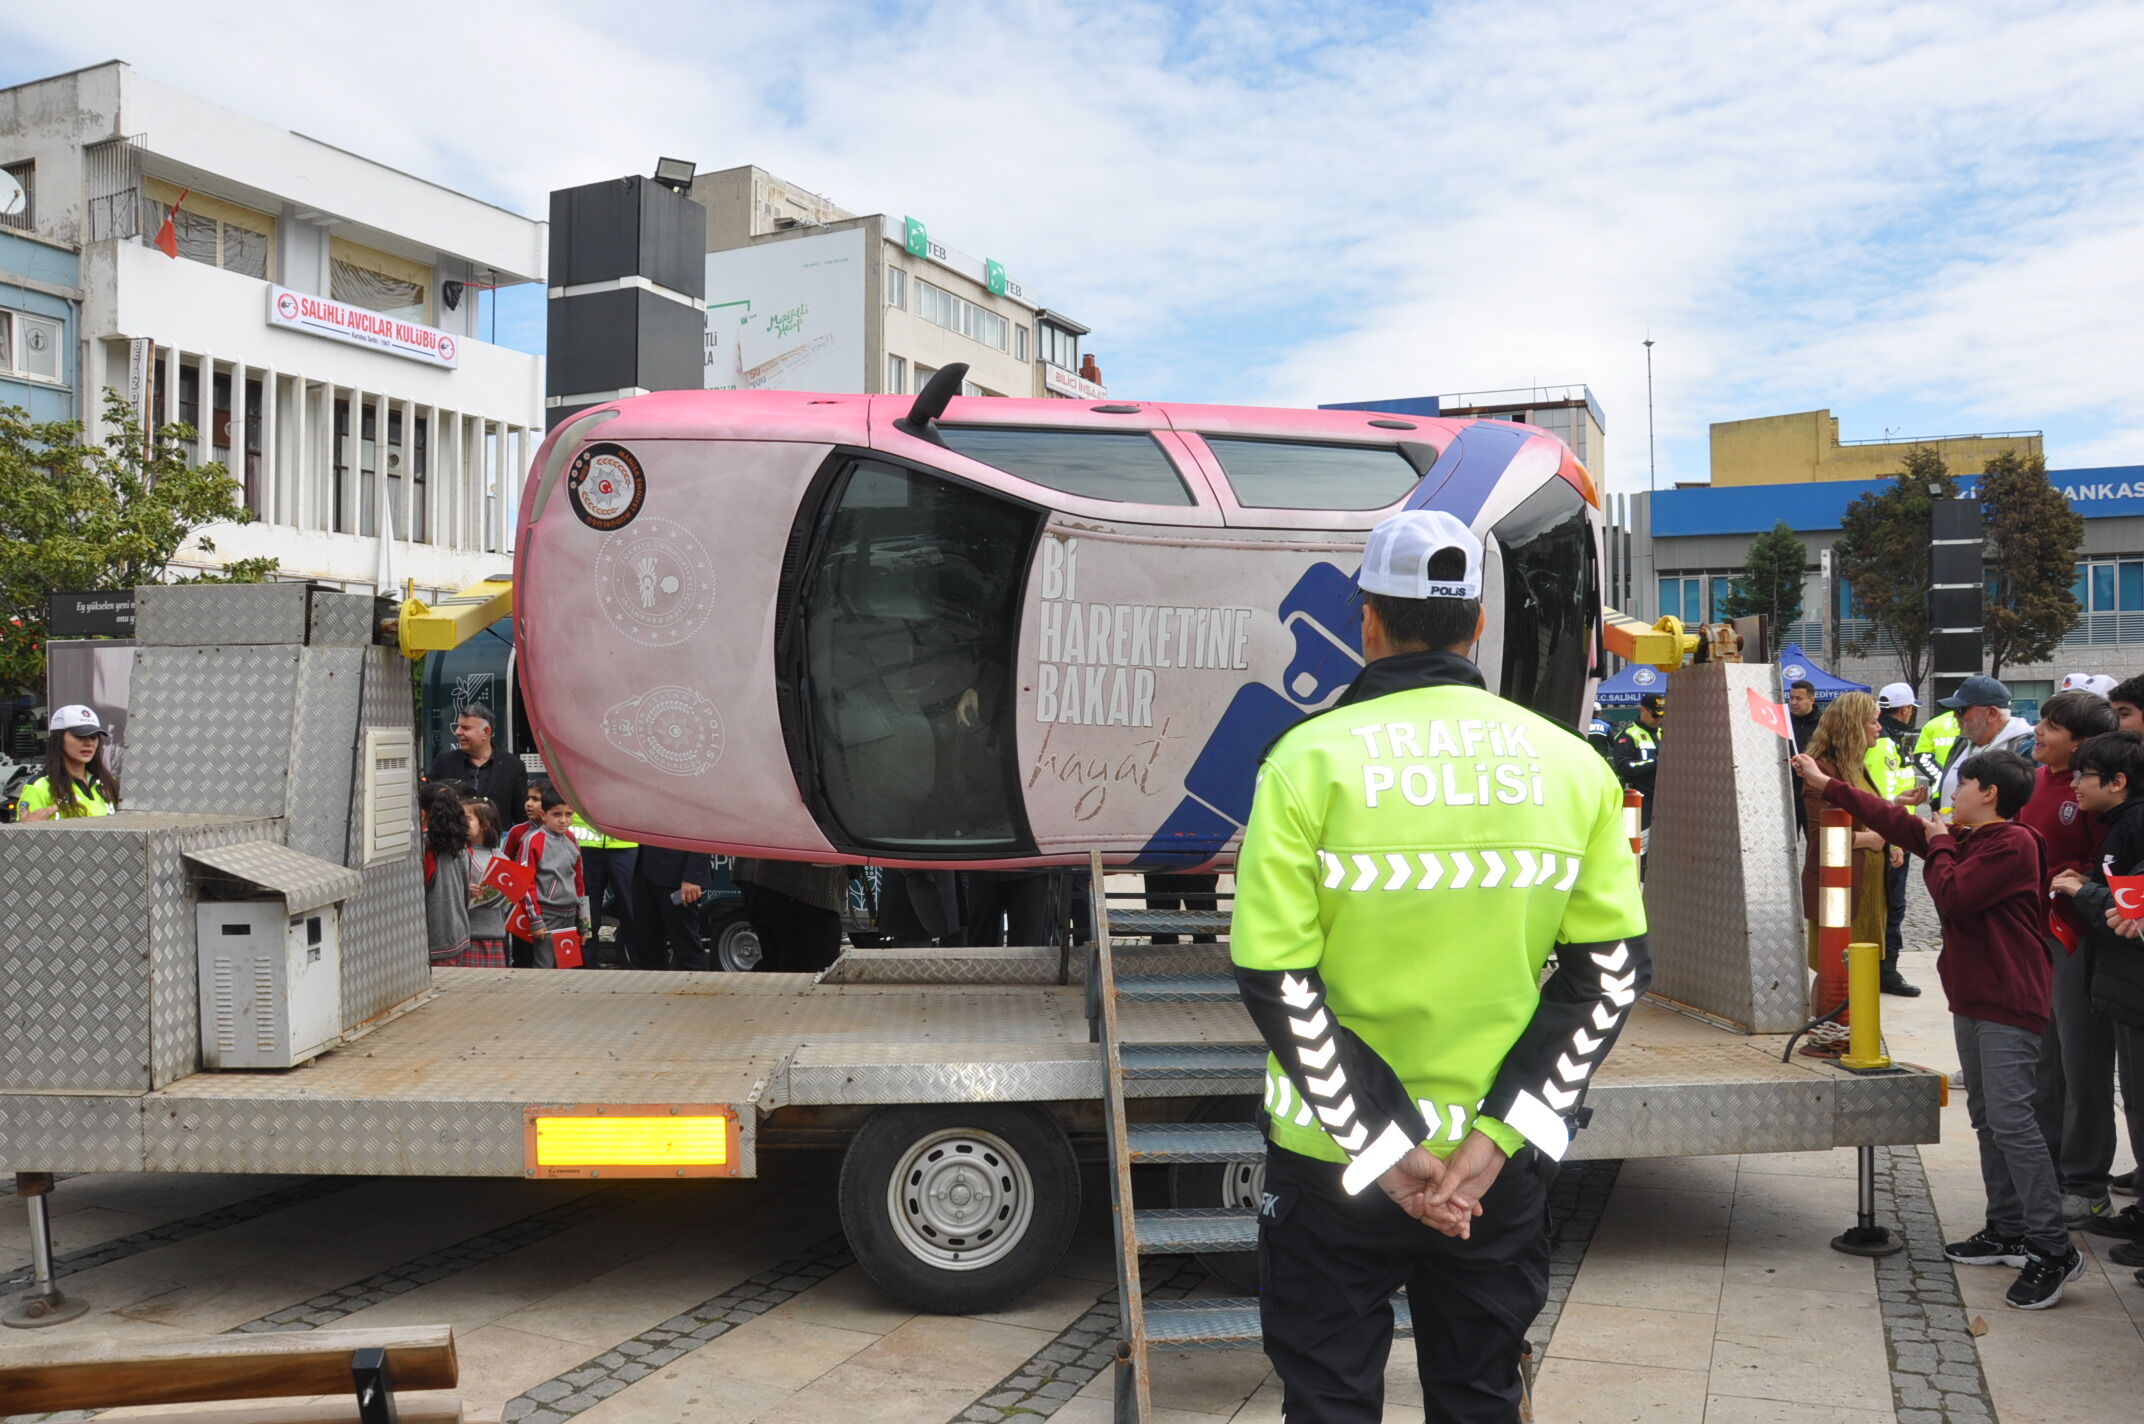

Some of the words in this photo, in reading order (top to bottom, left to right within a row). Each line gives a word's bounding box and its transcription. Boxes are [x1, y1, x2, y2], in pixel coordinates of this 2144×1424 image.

[927, 241, 946, 260] TEB
[1005, 280, 1022, 296] TEB
[301, 298, 345, 326] SALİHLİ
[347, 311, 393, 338] AVCILAR
[396, 323, 437, 350] KULÜBÜ
[2049, 481, 2144, 501] ANKAS
[1430, 585, 1467, 597] POLİS
[1039, 601, 1252, 670] HAREKETİNE
[1036, 664, 1156, 727] BAKAR
[1350, 719, 1539, 759] TRAFİK
[1361, 763, 1545, 809] POLİSİ
